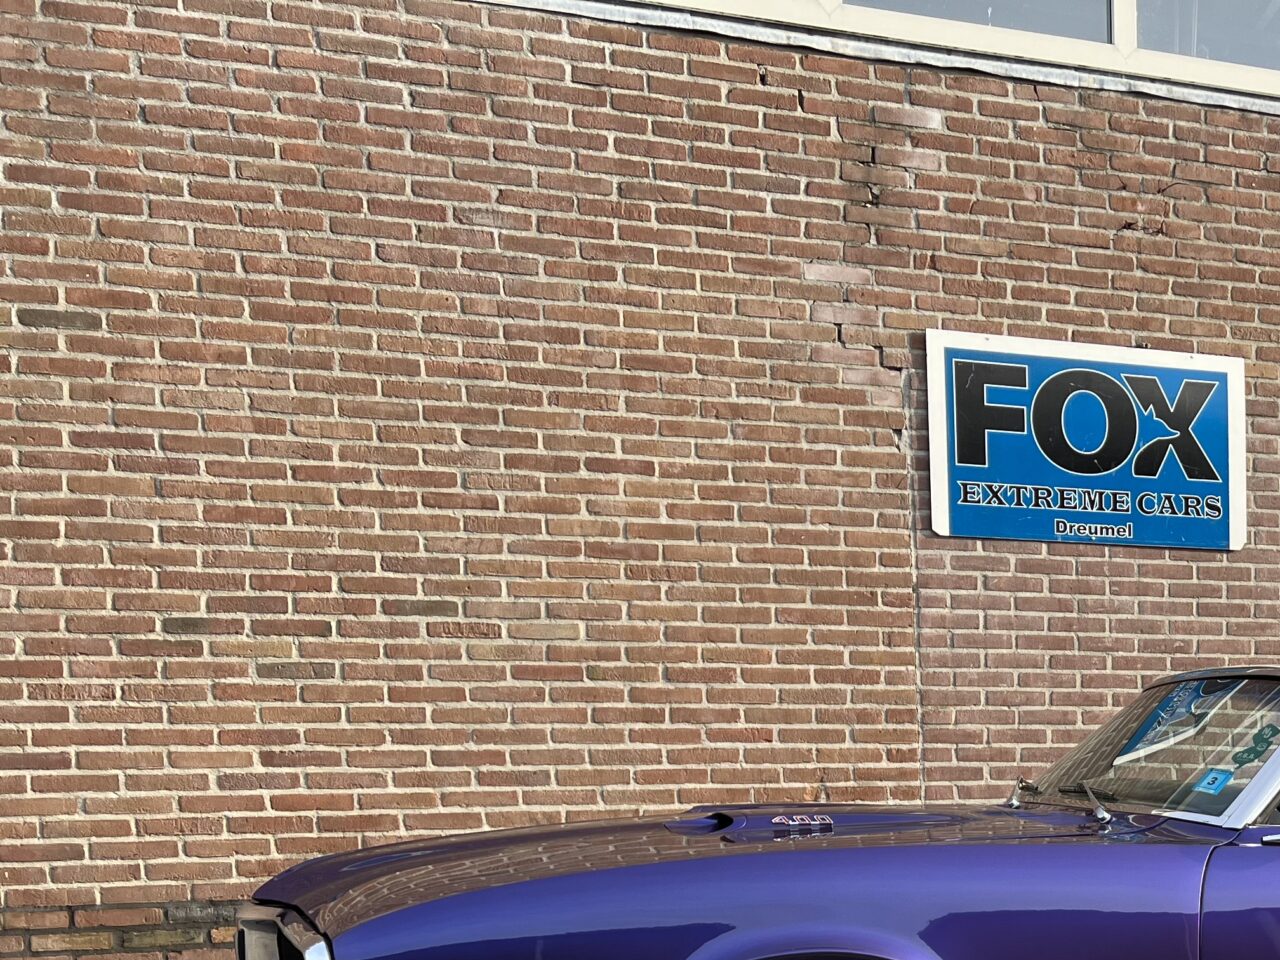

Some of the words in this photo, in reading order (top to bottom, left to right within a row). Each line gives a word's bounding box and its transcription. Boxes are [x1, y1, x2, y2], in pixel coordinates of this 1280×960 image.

[952, 358, 1222, 482] FOX
[957, 481, 1131, 513] EXTREME
[1136, 491, 1222, 519] CARS
[1055, 518, 1133, 538] Dreumel
[1207, 776, 1218, 786] 3
[771, 815, 834, 825] 400
